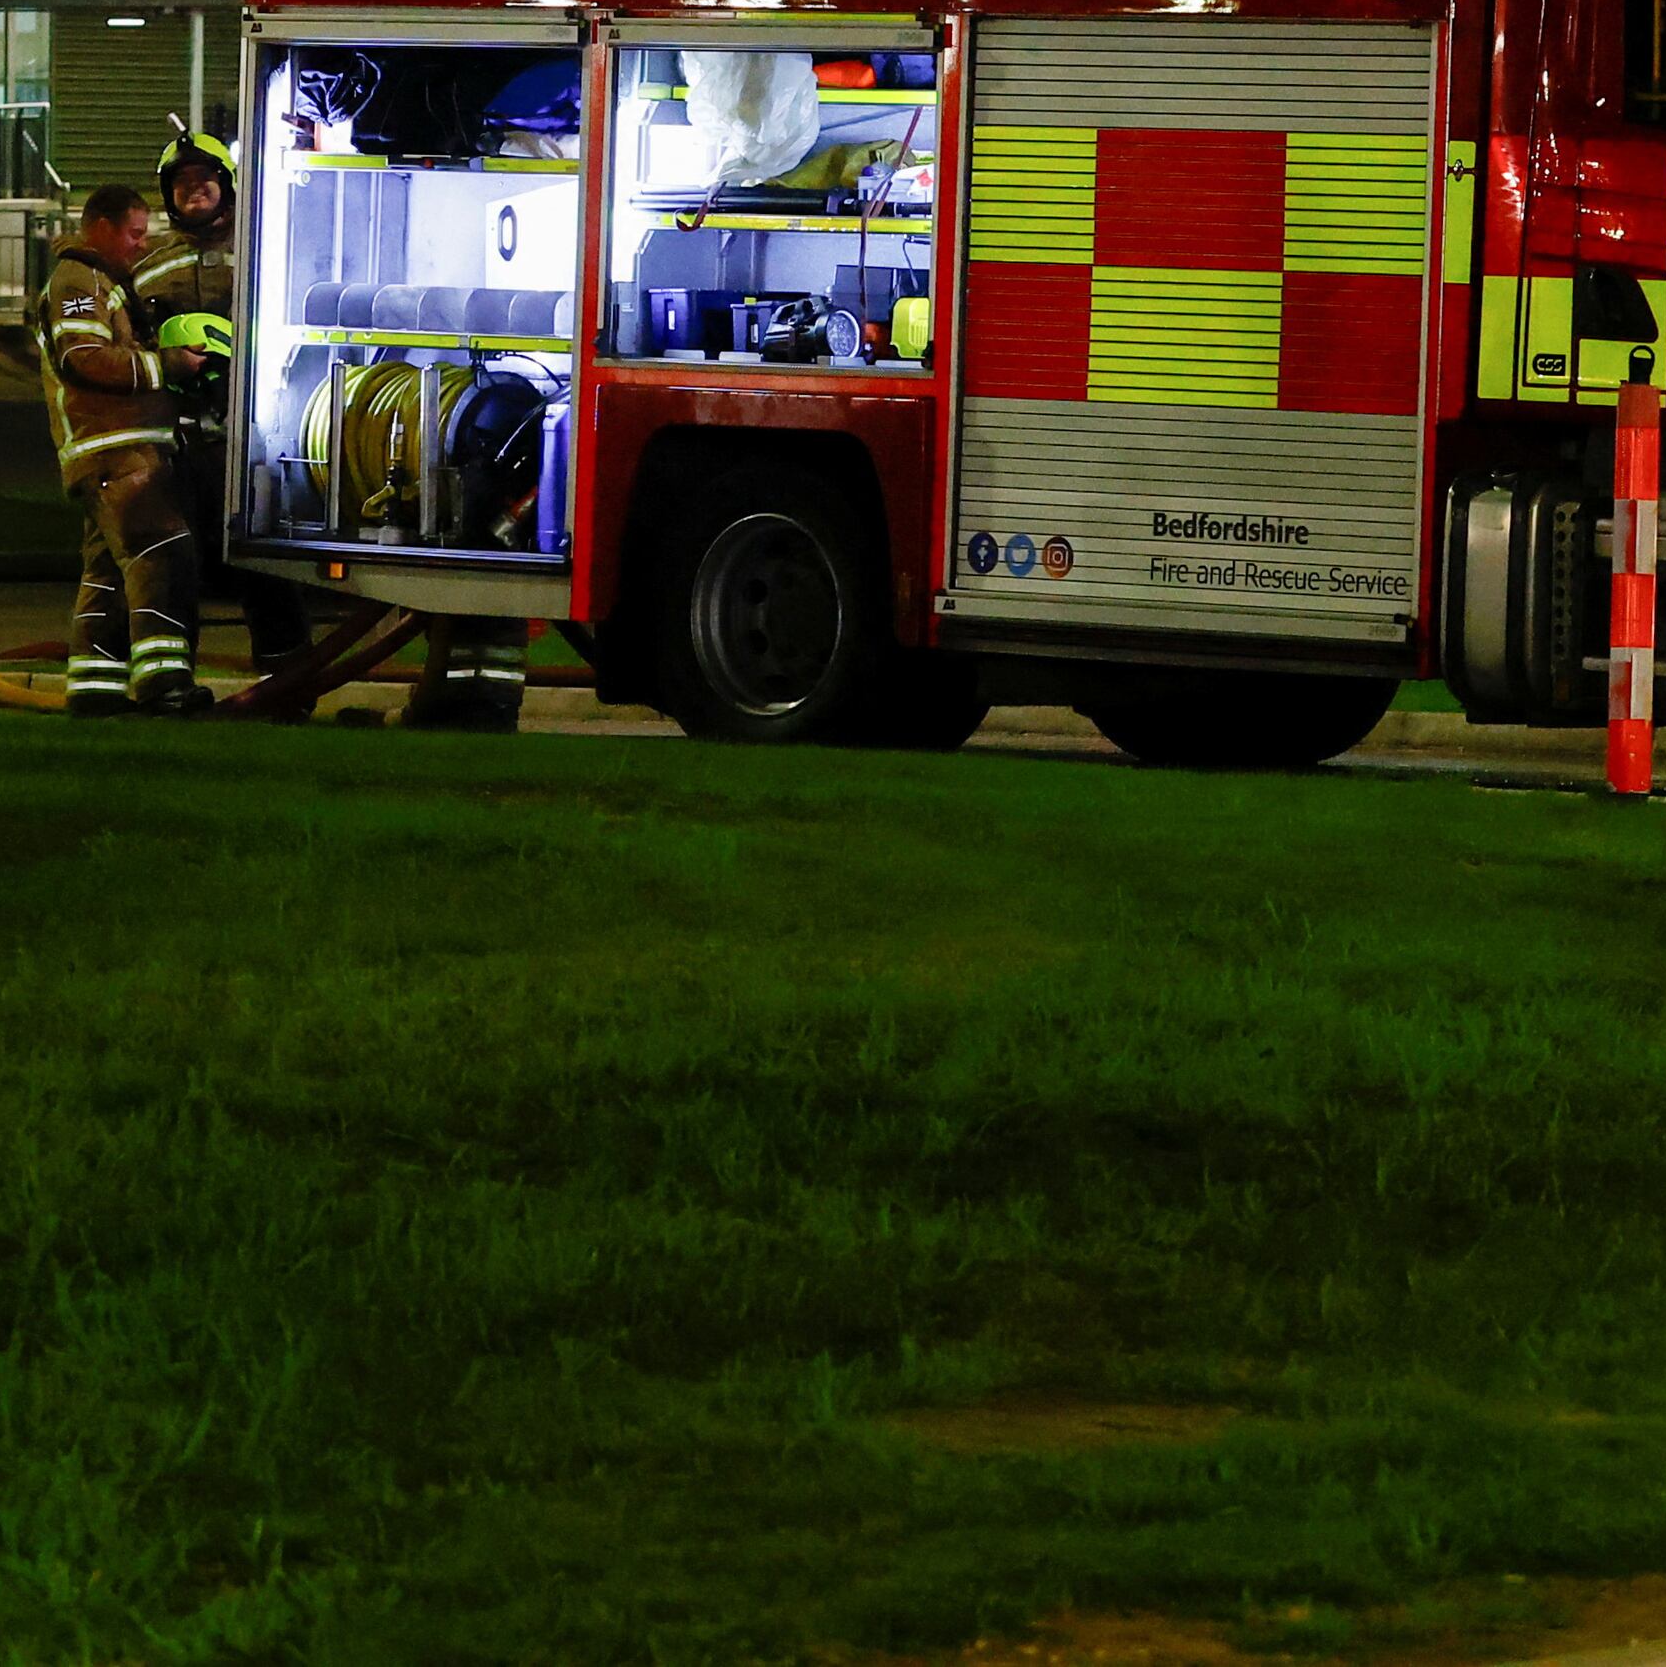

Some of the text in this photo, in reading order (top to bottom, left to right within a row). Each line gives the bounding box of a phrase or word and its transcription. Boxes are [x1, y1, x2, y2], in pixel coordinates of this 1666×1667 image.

[1152, 512, 1309, 545] Bedfordshire
[1150, 557, 1408, 597] Fire and Rescue Service
